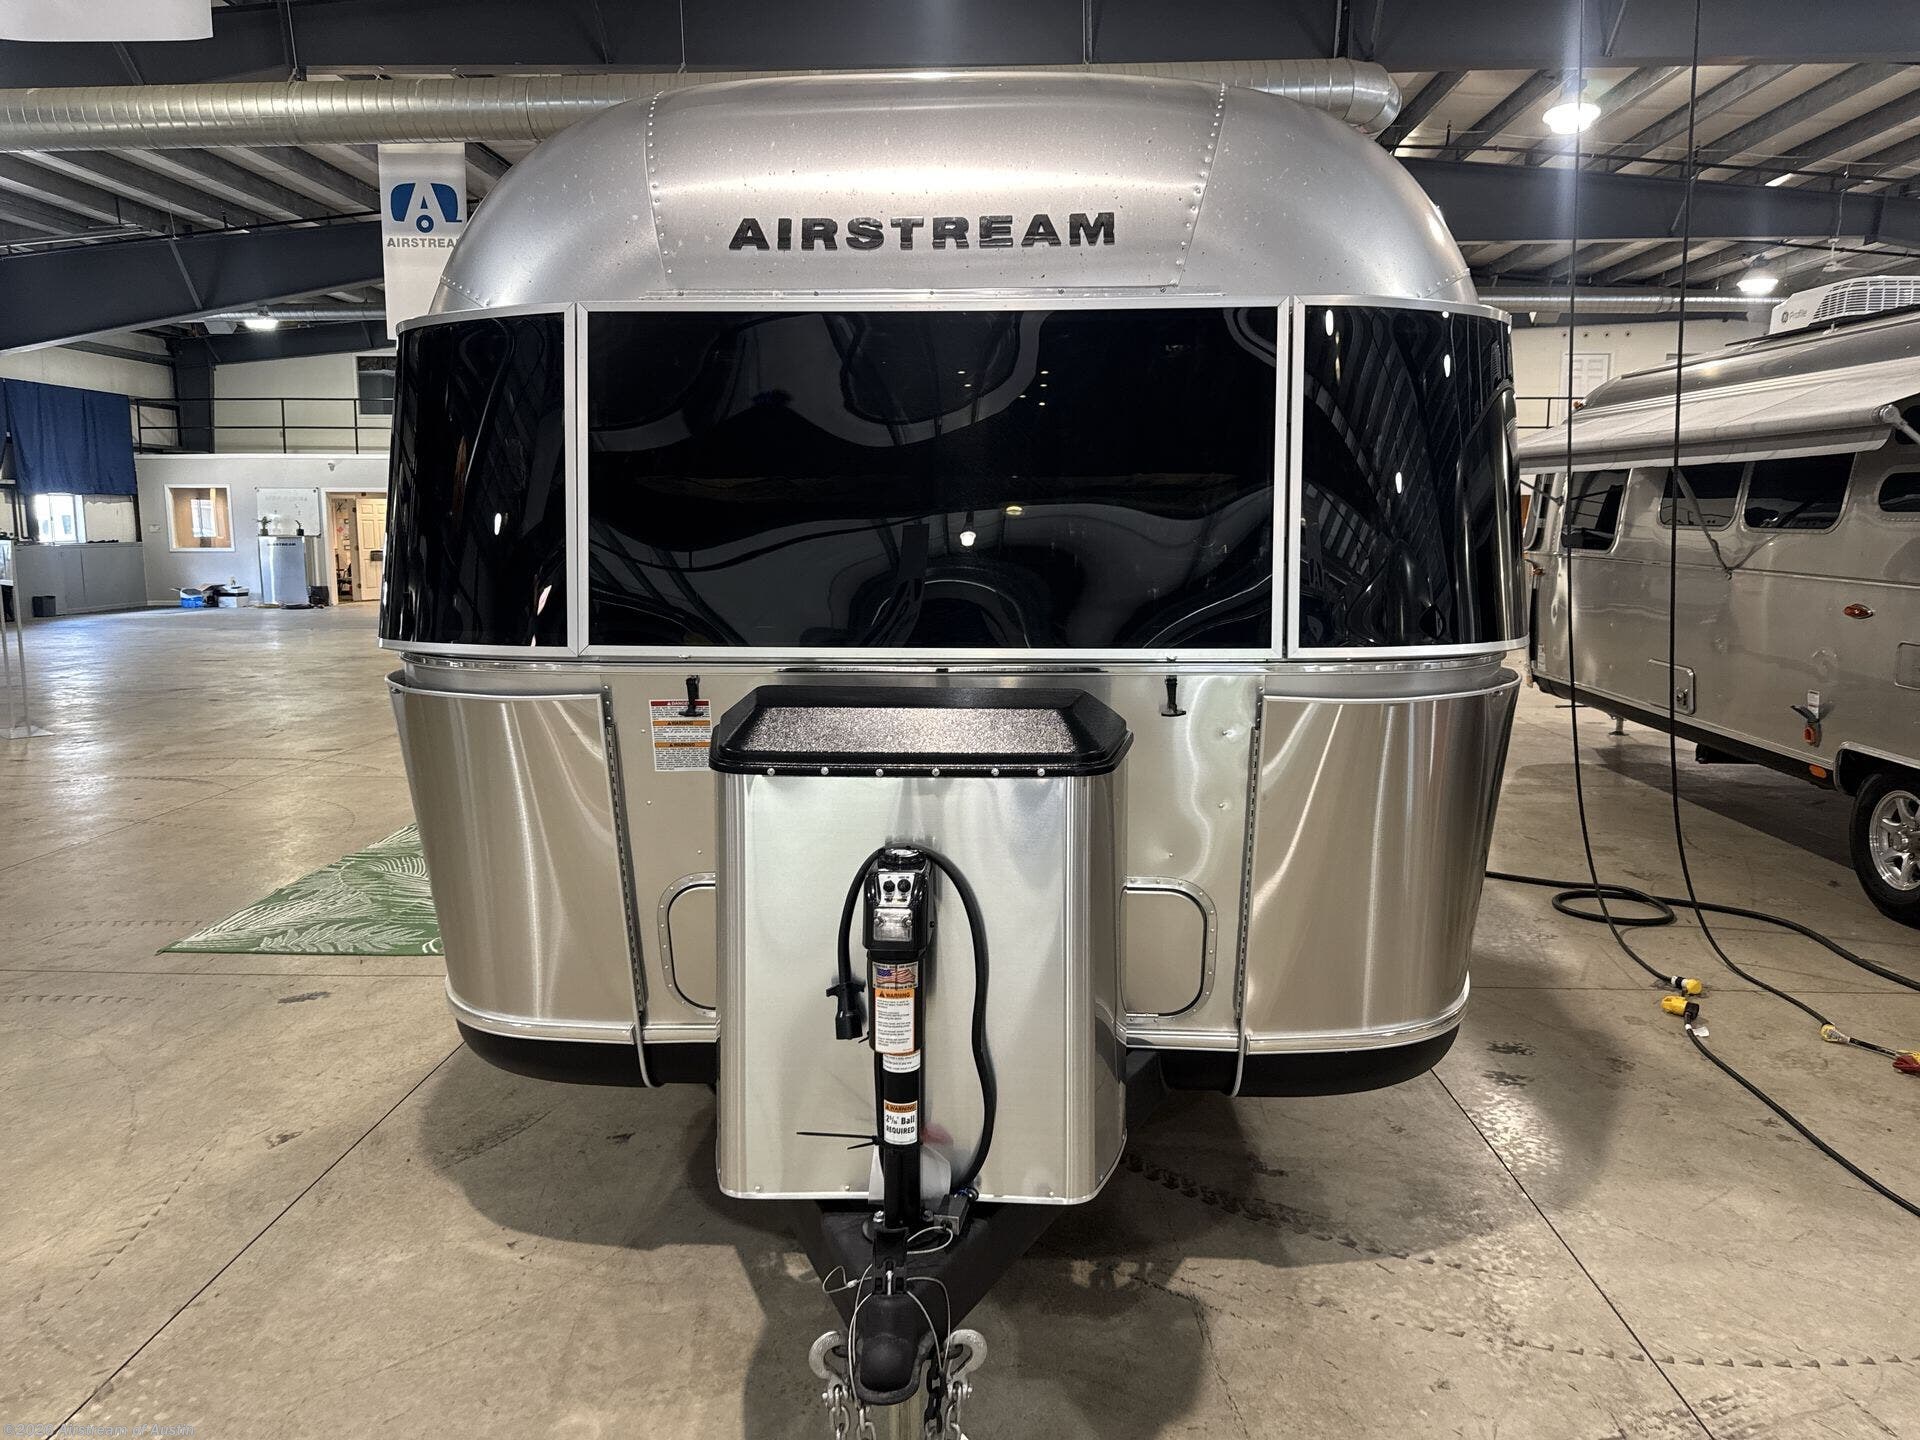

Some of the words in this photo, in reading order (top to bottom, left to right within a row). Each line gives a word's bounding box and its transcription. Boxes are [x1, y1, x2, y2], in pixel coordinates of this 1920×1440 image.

[729, 212, 1115, 250] AIRSTREAM
[386, 237, 461, 248] AIRSTREA
[901, 1115, 915, 1124] Ball
[886, 1125, 915, 1135] REQUIRED
